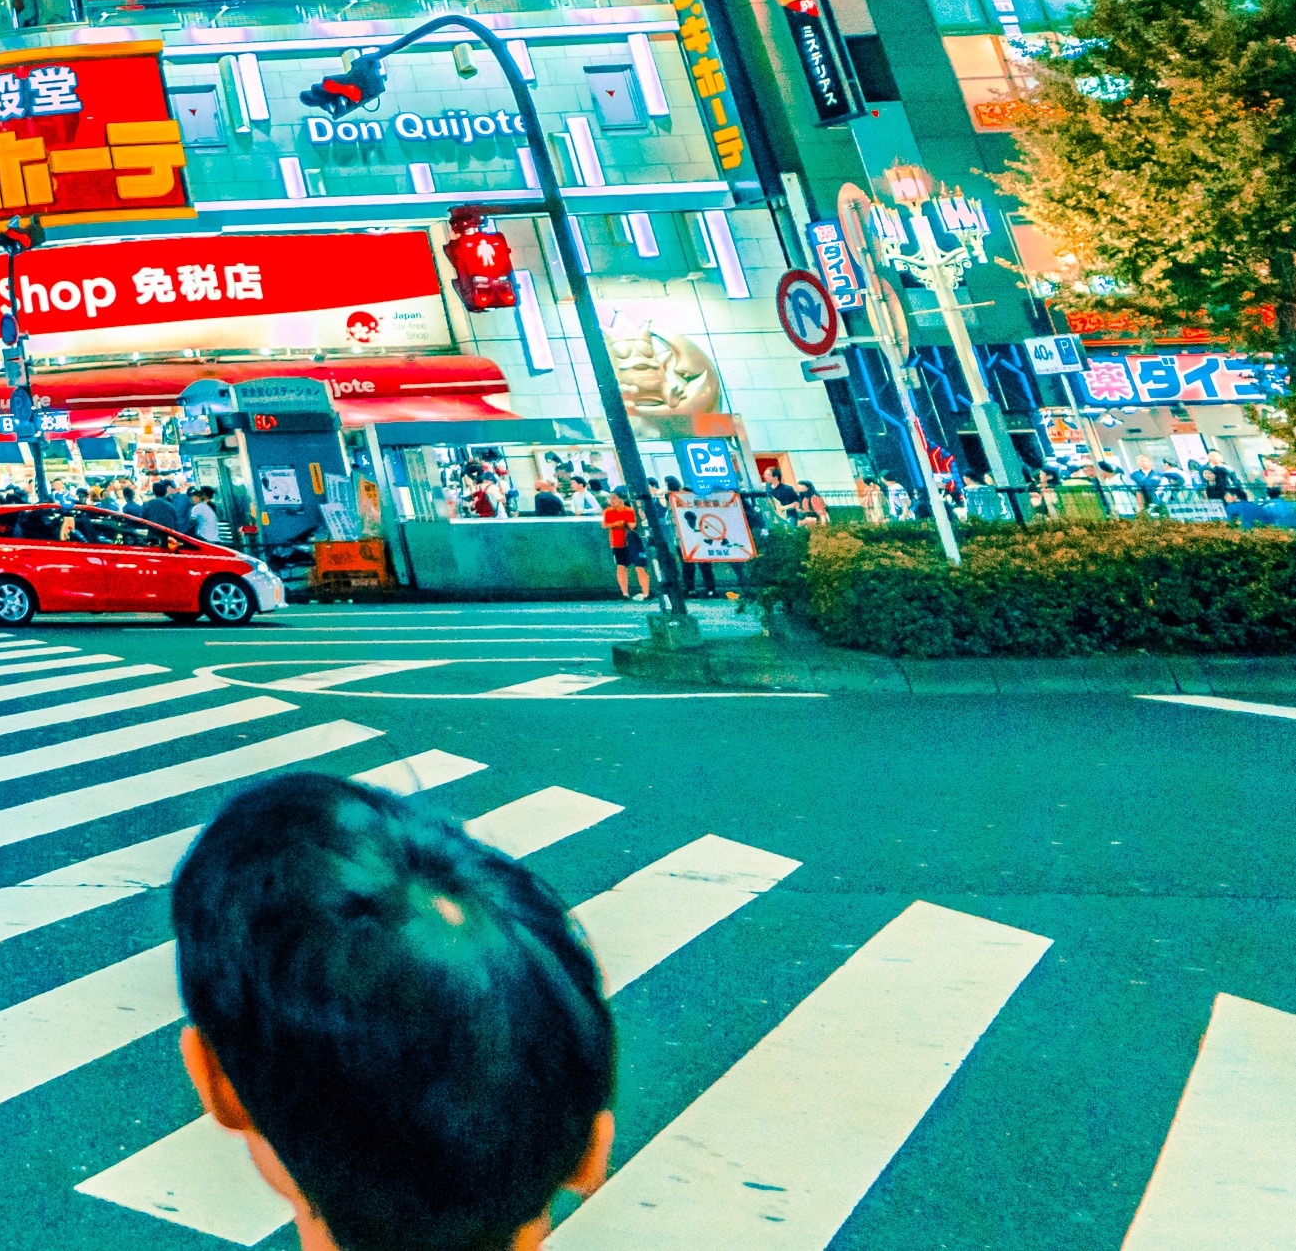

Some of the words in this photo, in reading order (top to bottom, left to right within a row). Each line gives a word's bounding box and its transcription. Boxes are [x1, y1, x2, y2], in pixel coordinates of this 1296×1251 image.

[802, 25, 839, 106] ミステリアス
[308, 115, 384, 143] Don
[132, 262, 264, 305] 免税店
[1086, 360, 1134, 401] 薬
